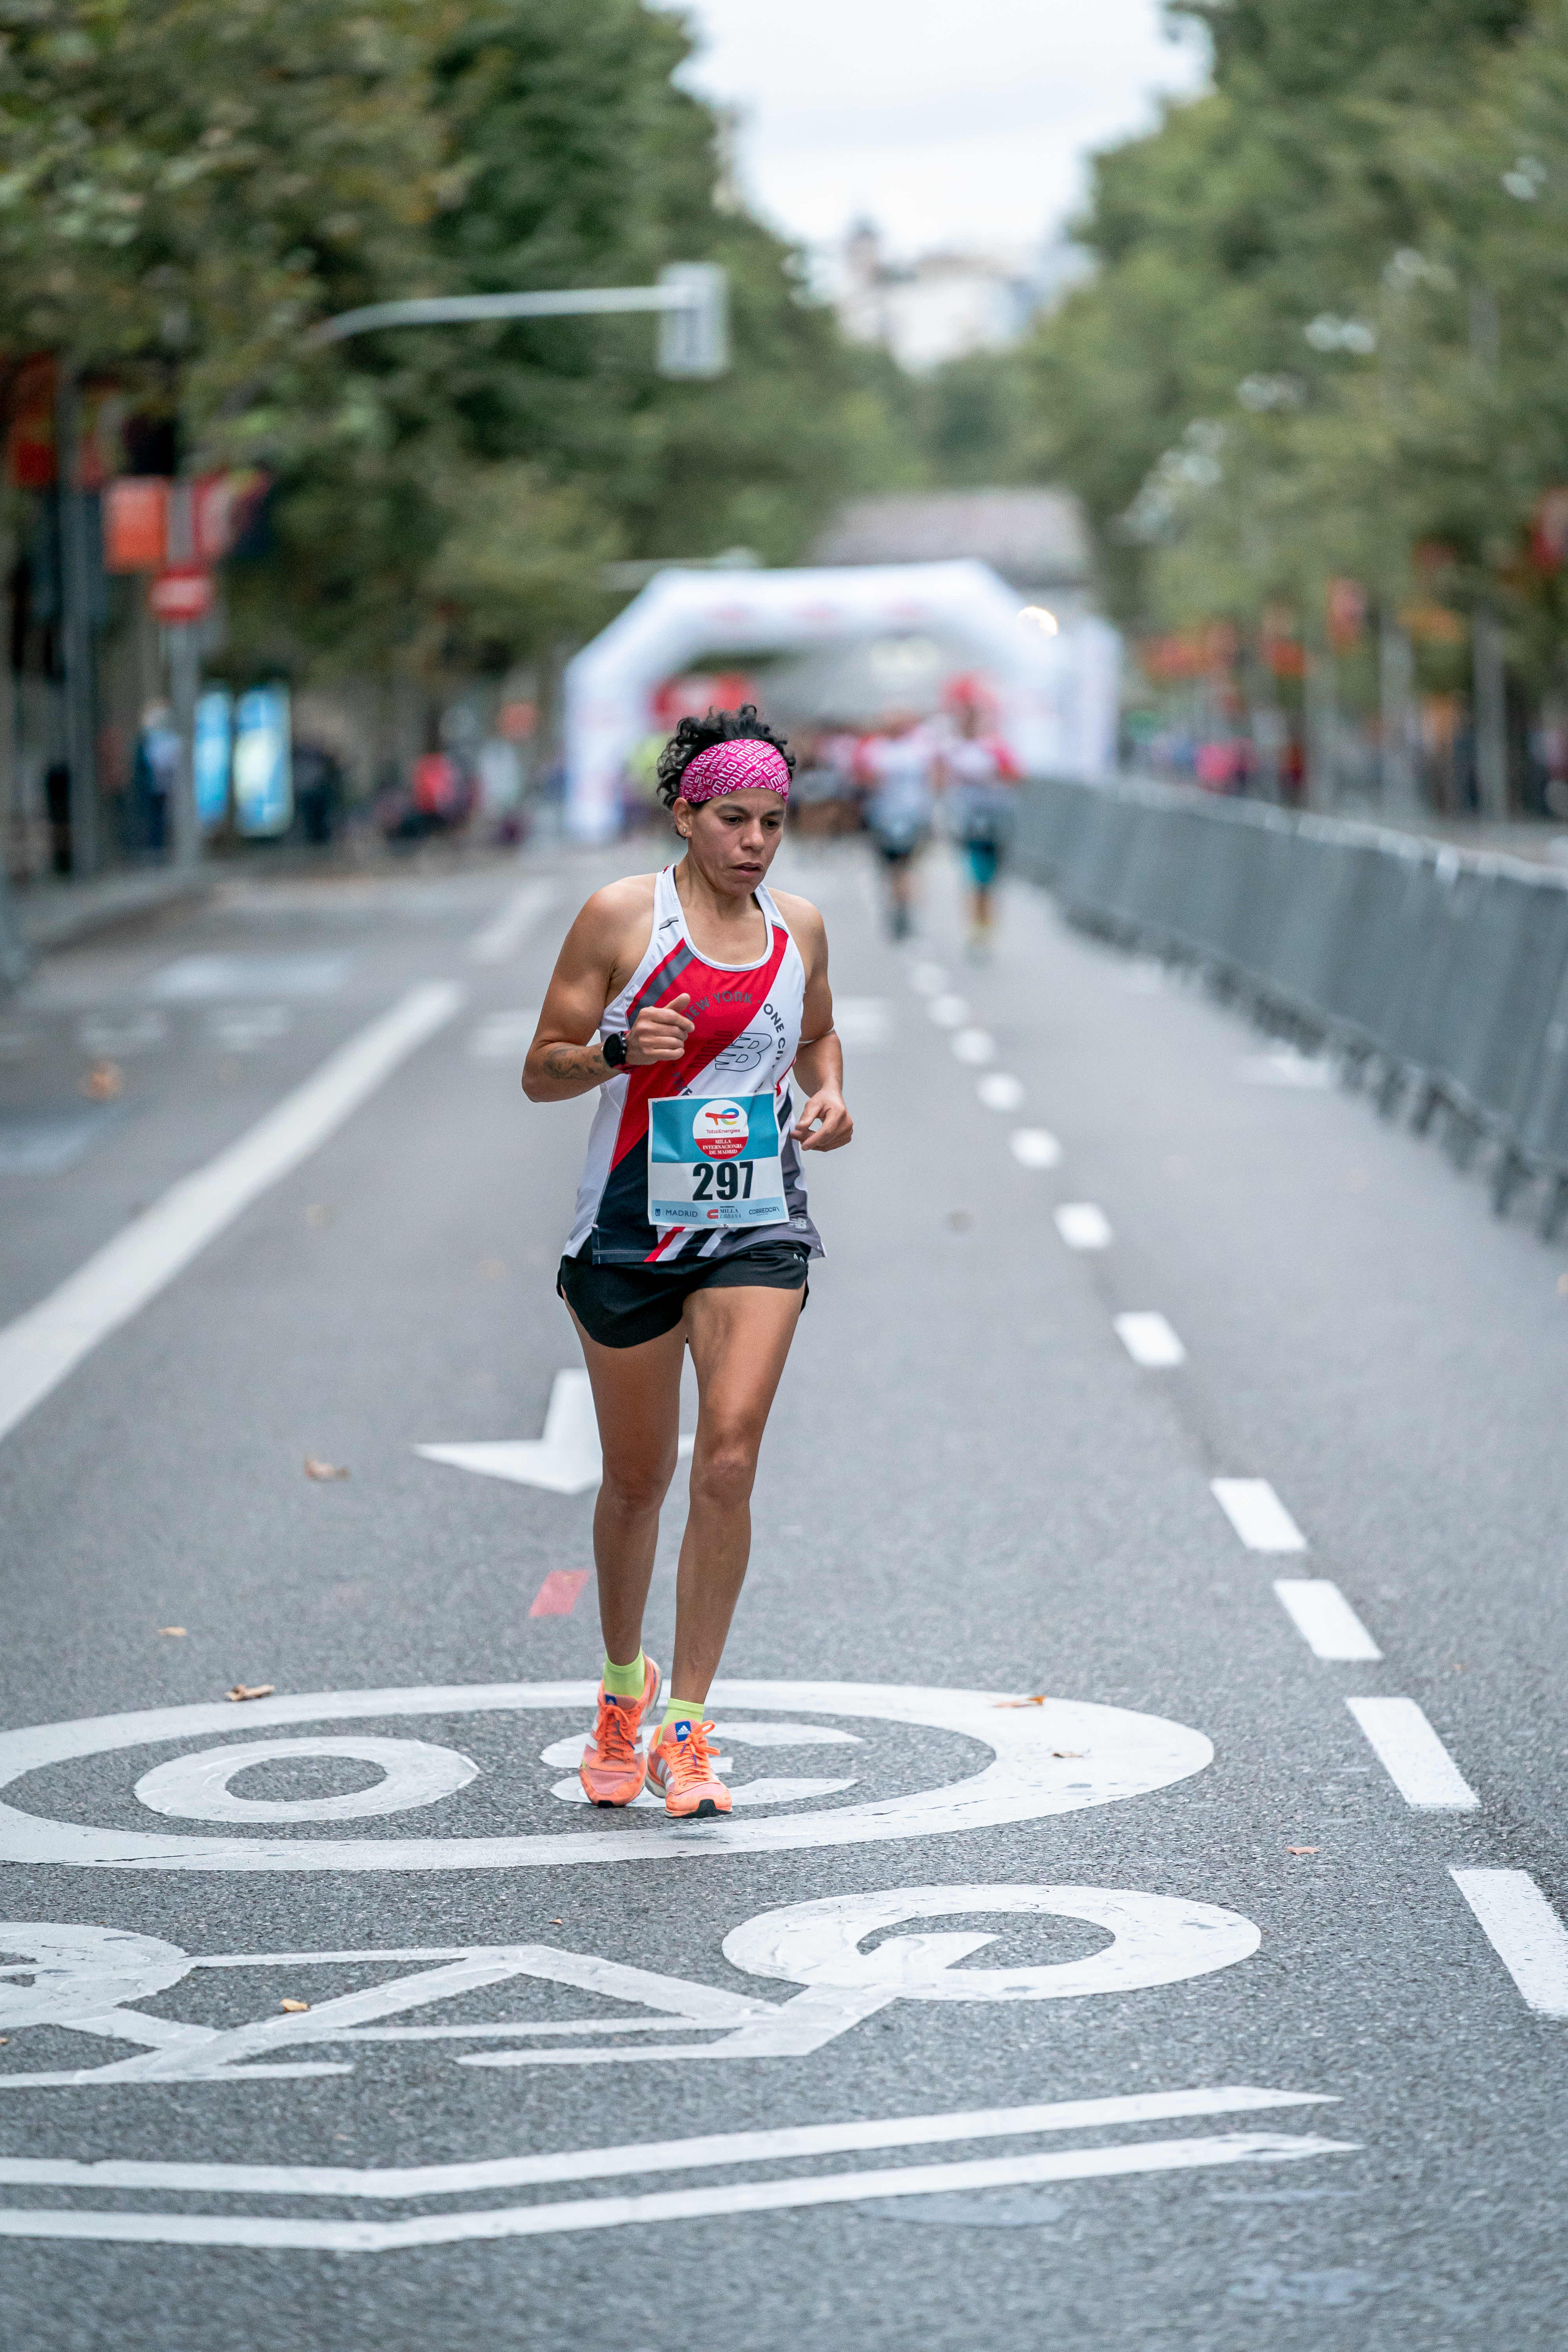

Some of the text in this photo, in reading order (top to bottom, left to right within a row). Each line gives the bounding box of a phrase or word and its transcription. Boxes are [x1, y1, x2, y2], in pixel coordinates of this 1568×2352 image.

[709, 752, 726, 771] mitto
[737, 741, 763, 760] mitto
[712, 762, 737, 793] mitto
[727, 761, 752, 787] mitto
[742, 769, 761, 788] mitto
[713, 991, 752, 1004] YORK
[764, 1004, 784, 1033] ONE
[692, 1161, 753, 1201] 297
